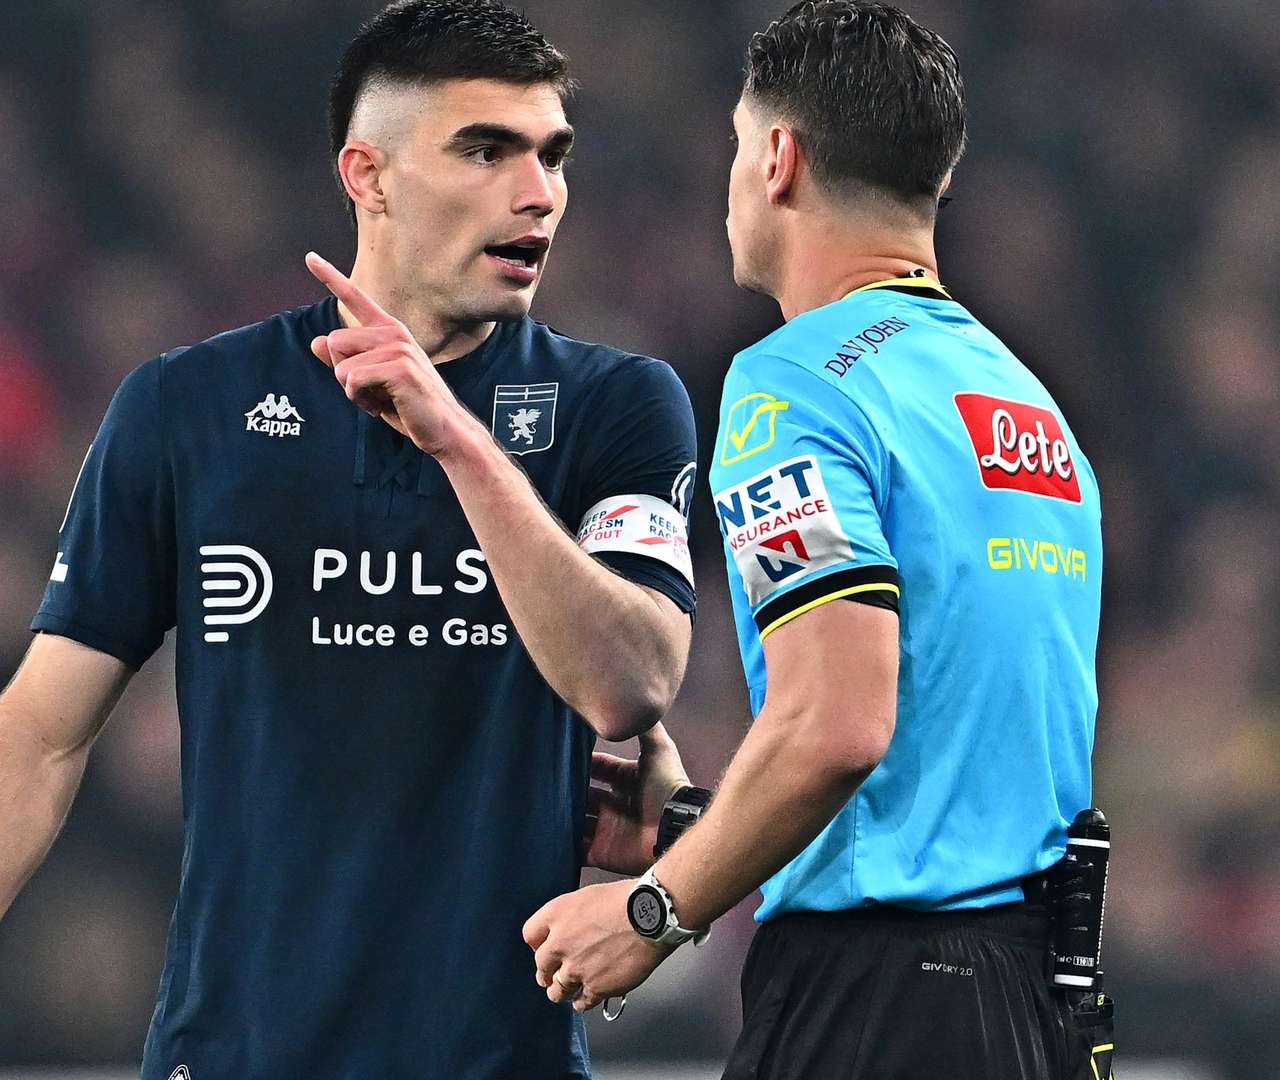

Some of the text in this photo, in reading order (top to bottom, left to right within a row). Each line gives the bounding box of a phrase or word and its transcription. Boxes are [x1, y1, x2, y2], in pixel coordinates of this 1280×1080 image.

[824, 316, 911, 378] DAN JOHN
[246, 416, 301, 438] Kappa
[980, 408, 1072, 480] Lete
[717, 460, 813, 536] NET
[594, 529, 622, 541] OUT
[730, 500, 828, 551] NSURANCE
[312, 548, 488, 595] PULS
[986, 537, 1087, 583] GIVOVA
[312, 616, 507, 646] Luce e Gas
